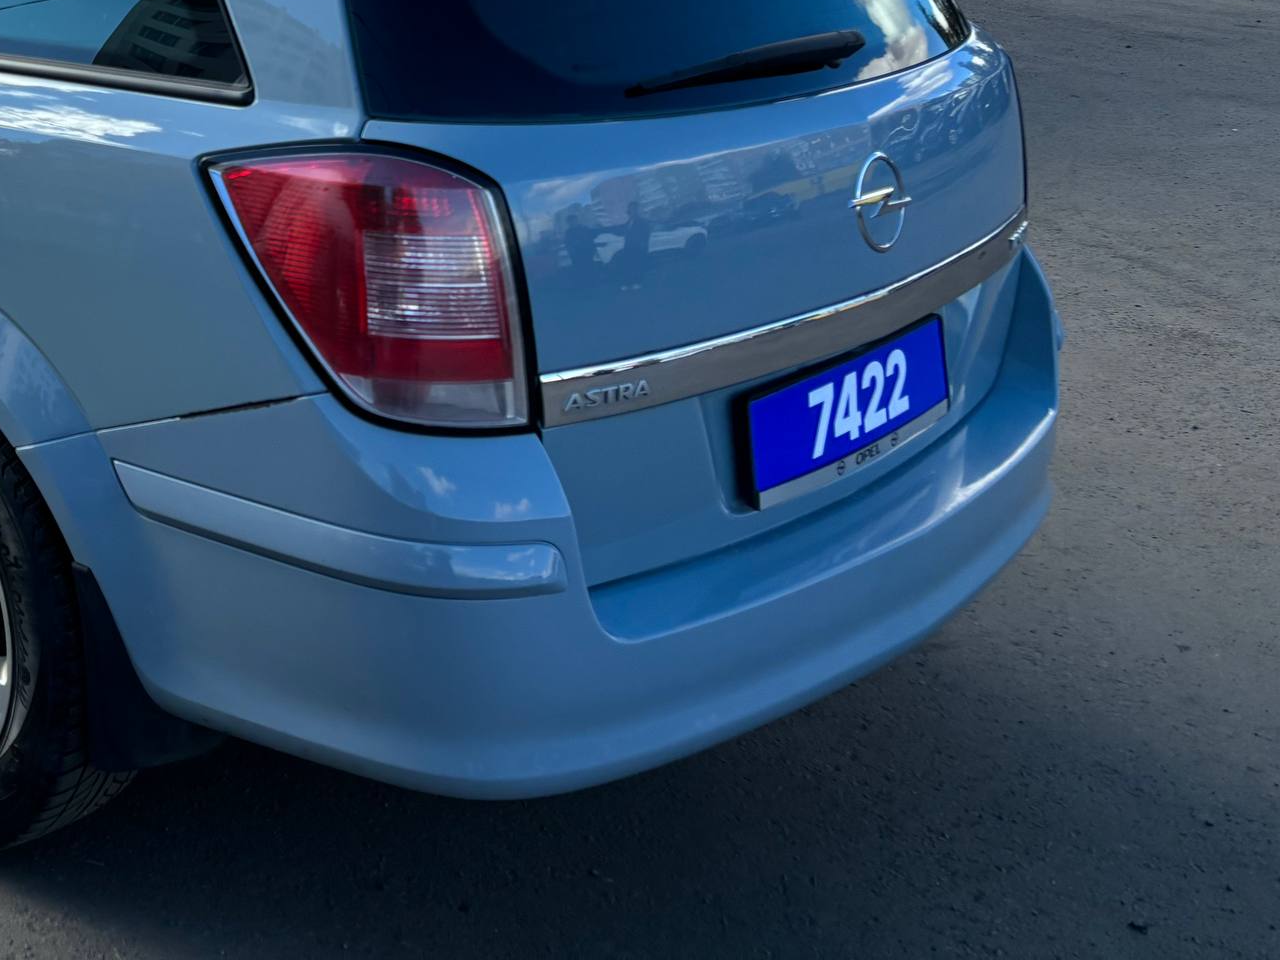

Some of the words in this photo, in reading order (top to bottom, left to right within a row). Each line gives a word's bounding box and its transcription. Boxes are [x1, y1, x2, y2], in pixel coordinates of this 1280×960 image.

[563, 379, 651, 412] ASTRA
[808, 349, 910, 460] 7422
[855, 443, 881, 465] OPEL
